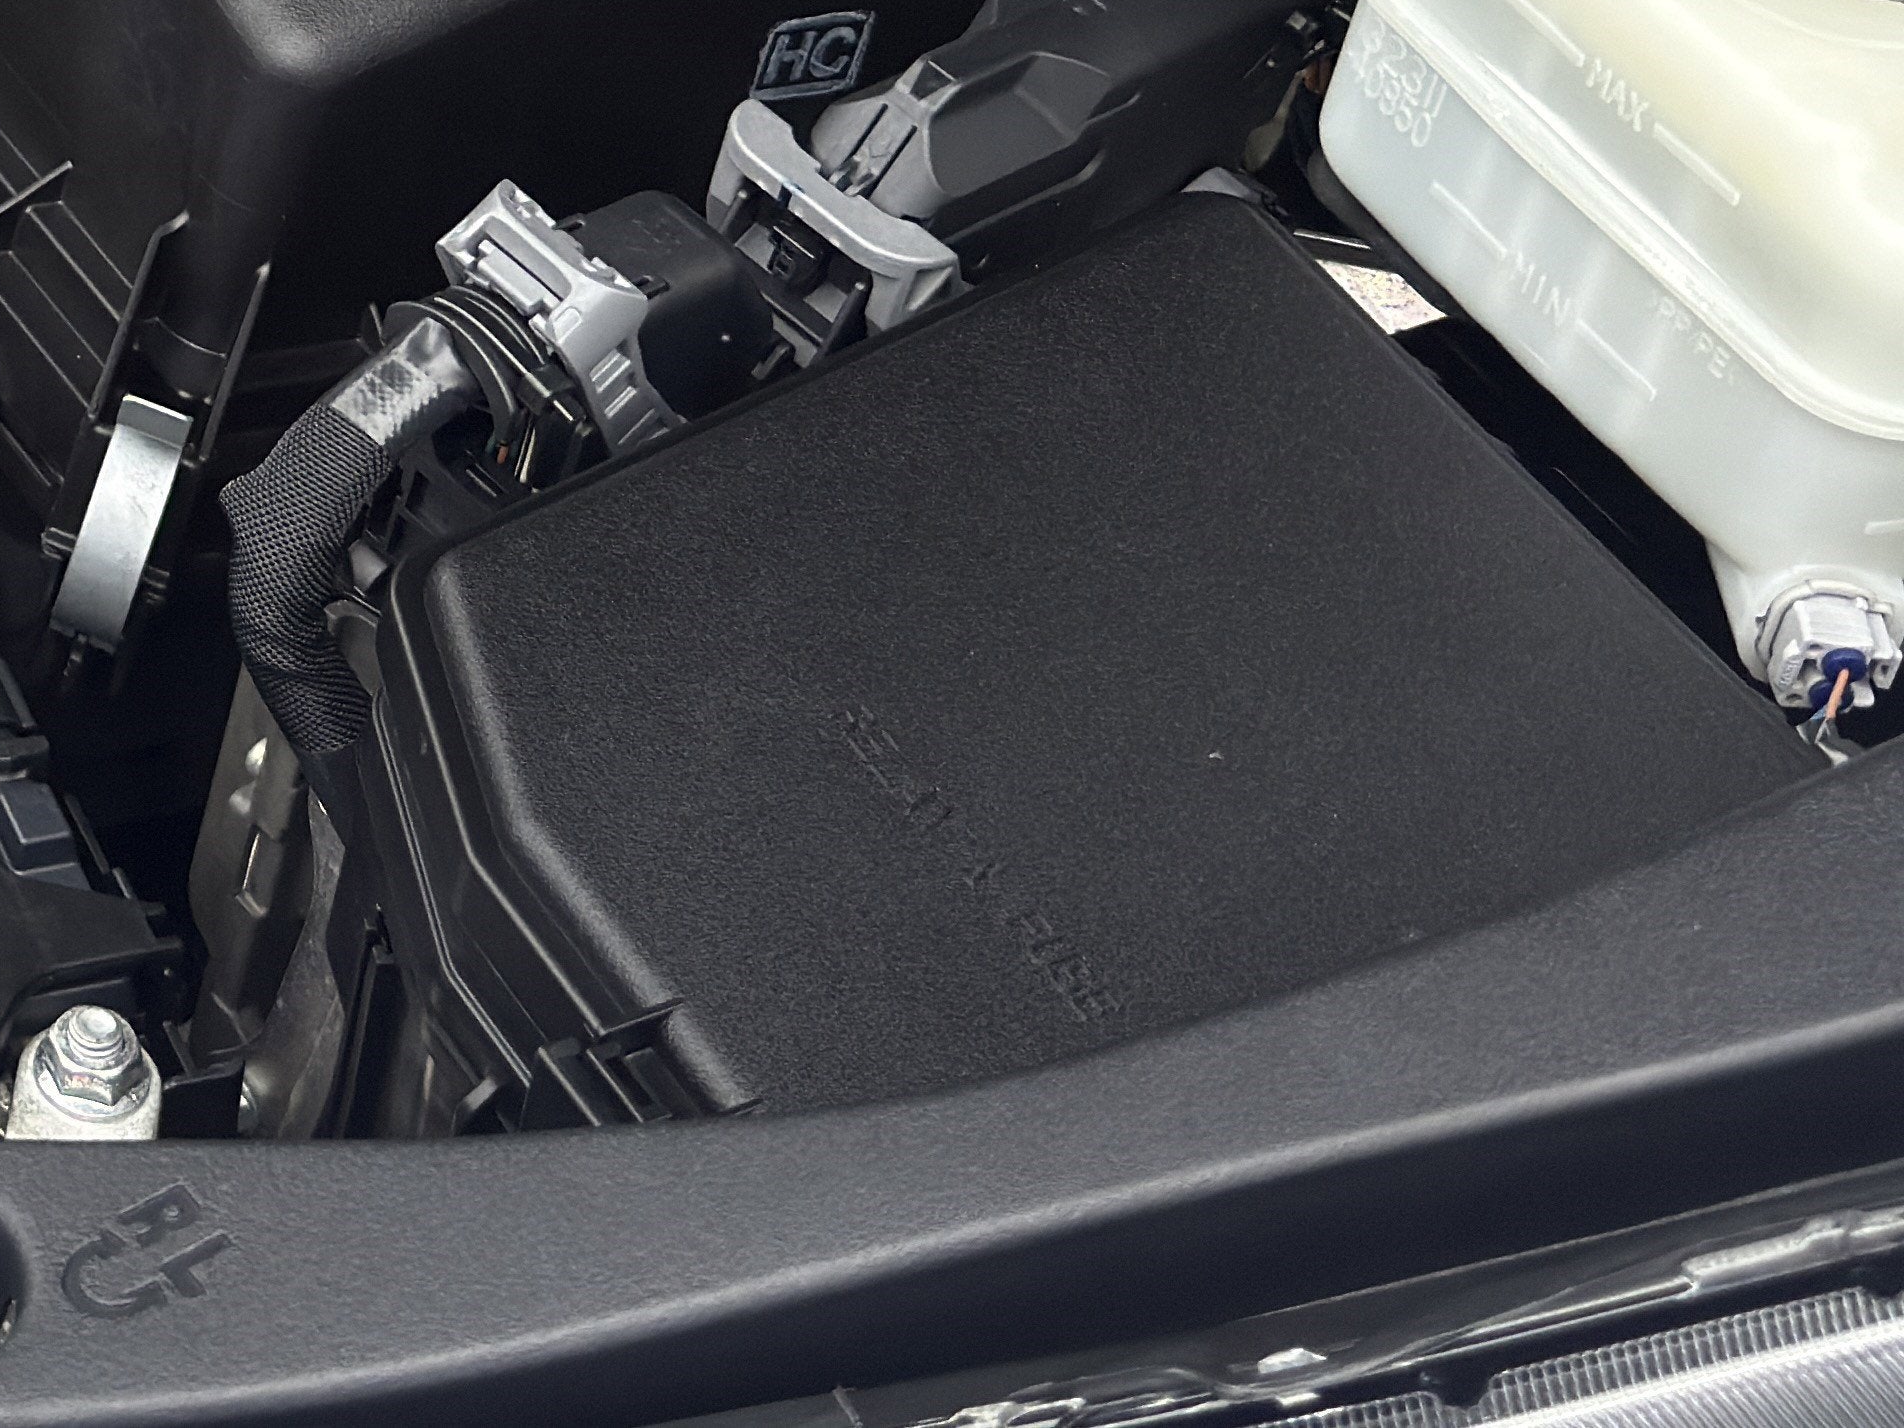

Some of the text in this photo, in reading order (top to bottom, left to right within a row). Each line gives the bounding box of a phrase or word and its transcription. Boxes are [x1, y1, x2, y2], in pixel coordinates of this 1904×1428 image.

[762, 26, 858, 84] HC
[1586, 58, 1649, 132] MAX
[1512, 251, 1570, 327] MIN
